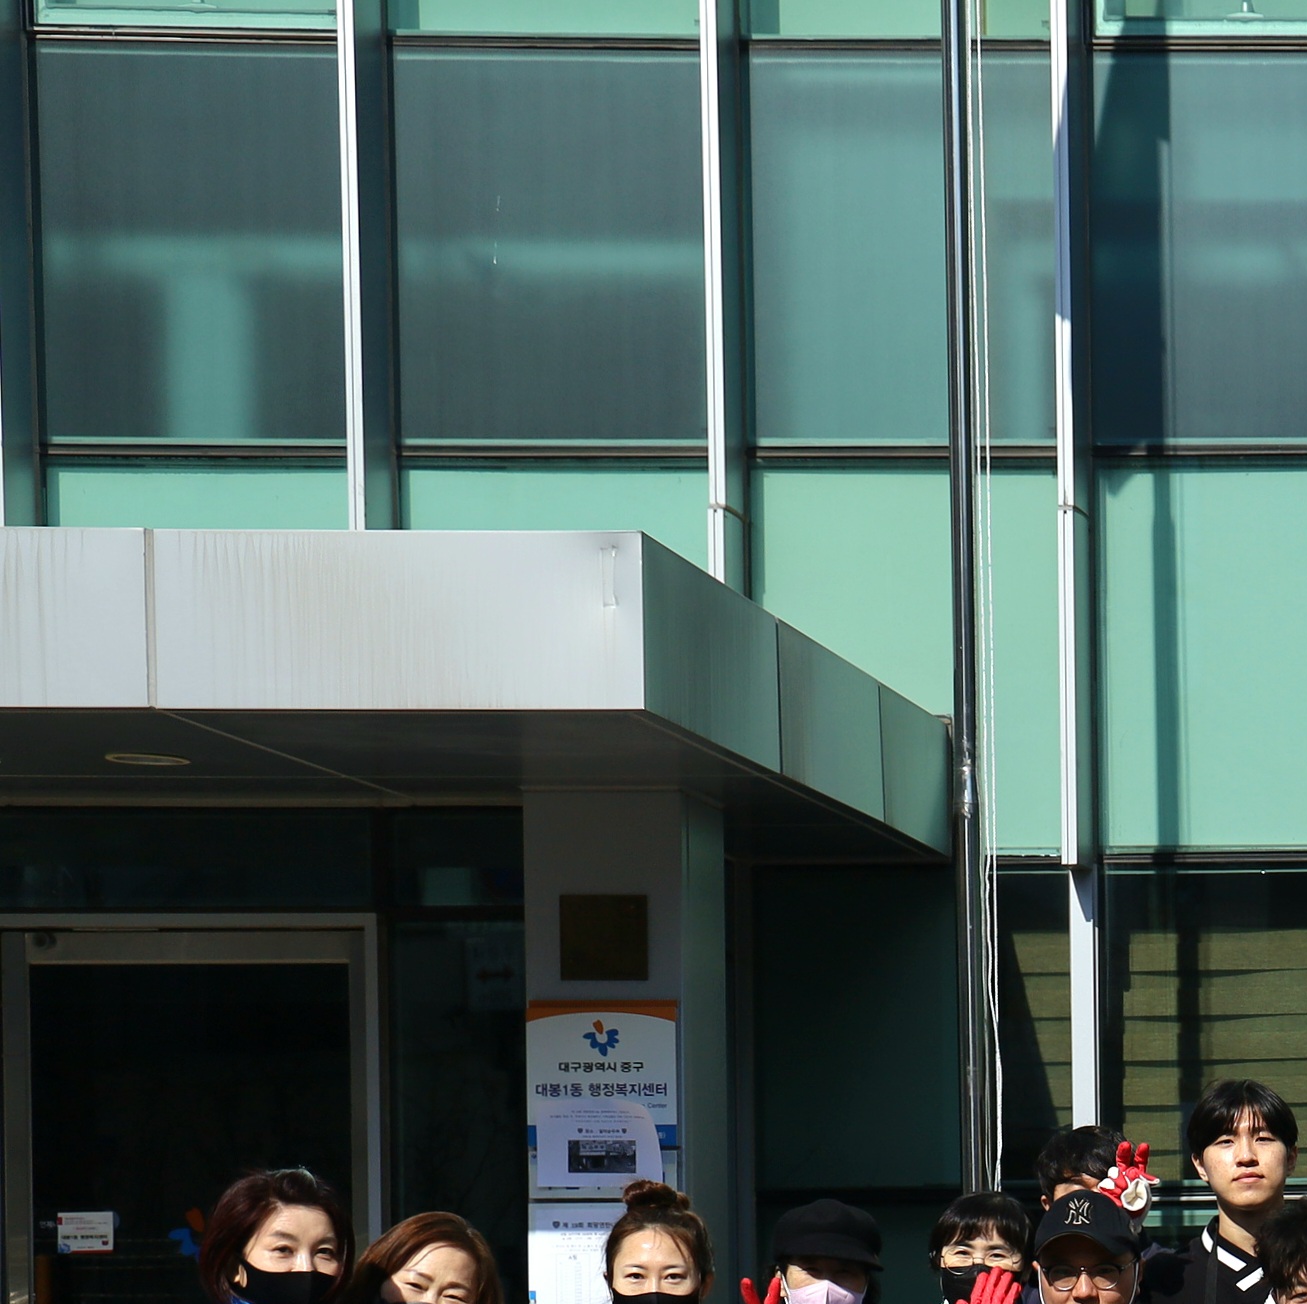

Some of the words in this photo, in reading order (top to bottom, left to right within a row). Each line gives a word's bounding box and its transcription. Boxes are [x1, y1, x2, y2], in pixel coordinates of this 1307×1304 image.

[558, 1062, 617, 1073] 대구광역시
[620, 1062, 644, 1073] 중구
[535, 1083, 583, 1097] 대봉1동
[588, 1083, 668, 1097] 행정복지센터
